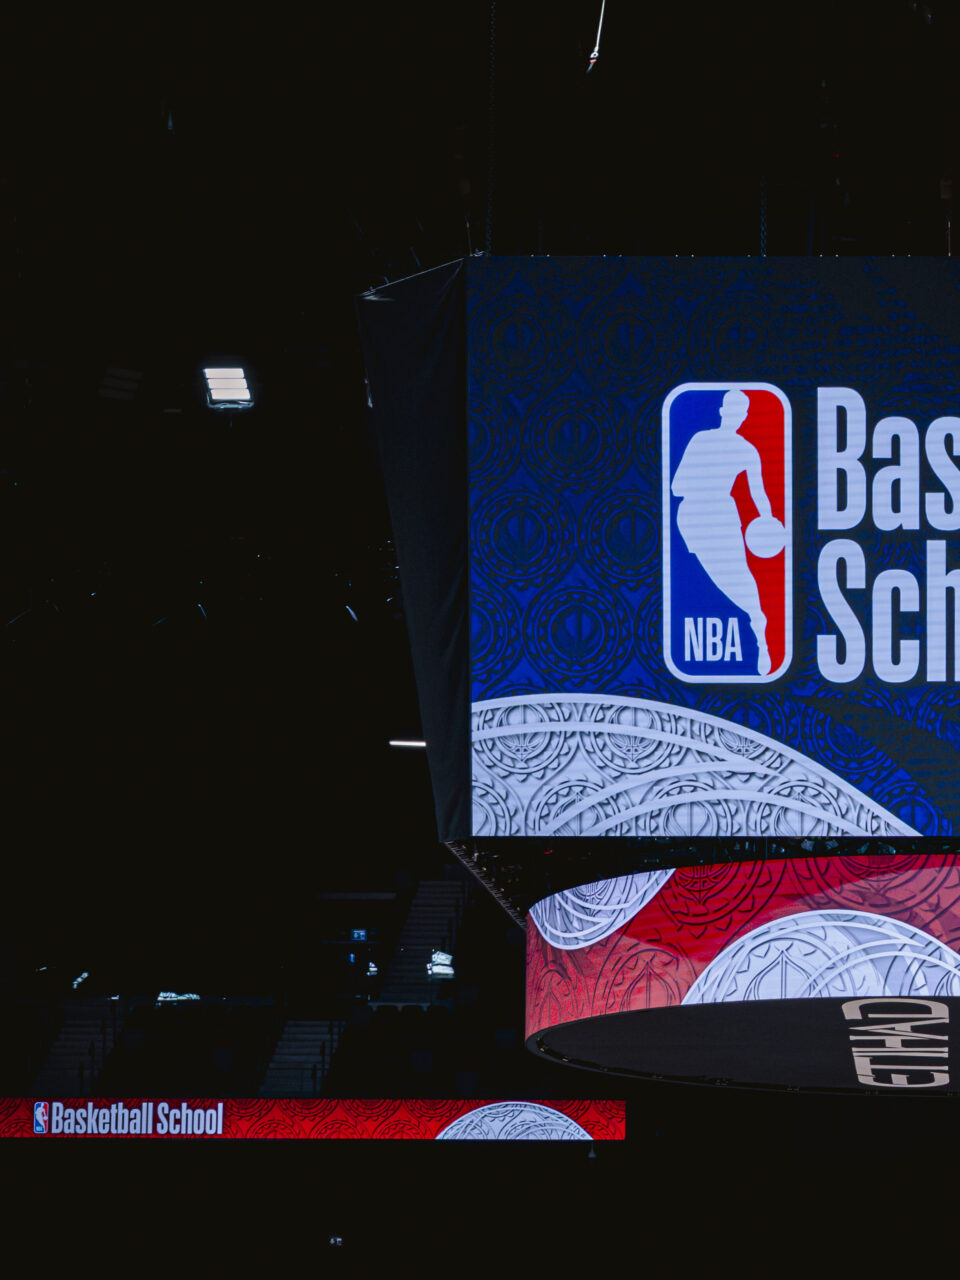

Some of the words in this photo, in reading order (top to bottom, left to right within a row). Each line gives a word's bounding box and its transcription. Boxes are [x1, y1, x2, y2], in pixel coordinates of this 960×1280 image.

[684, 617, 743, 662] NBA
[841, 998, 950, 1087] ETIHAD
[51, 1102, 153, 1135] Basketball
[157, 1102, 223, 1135] School
